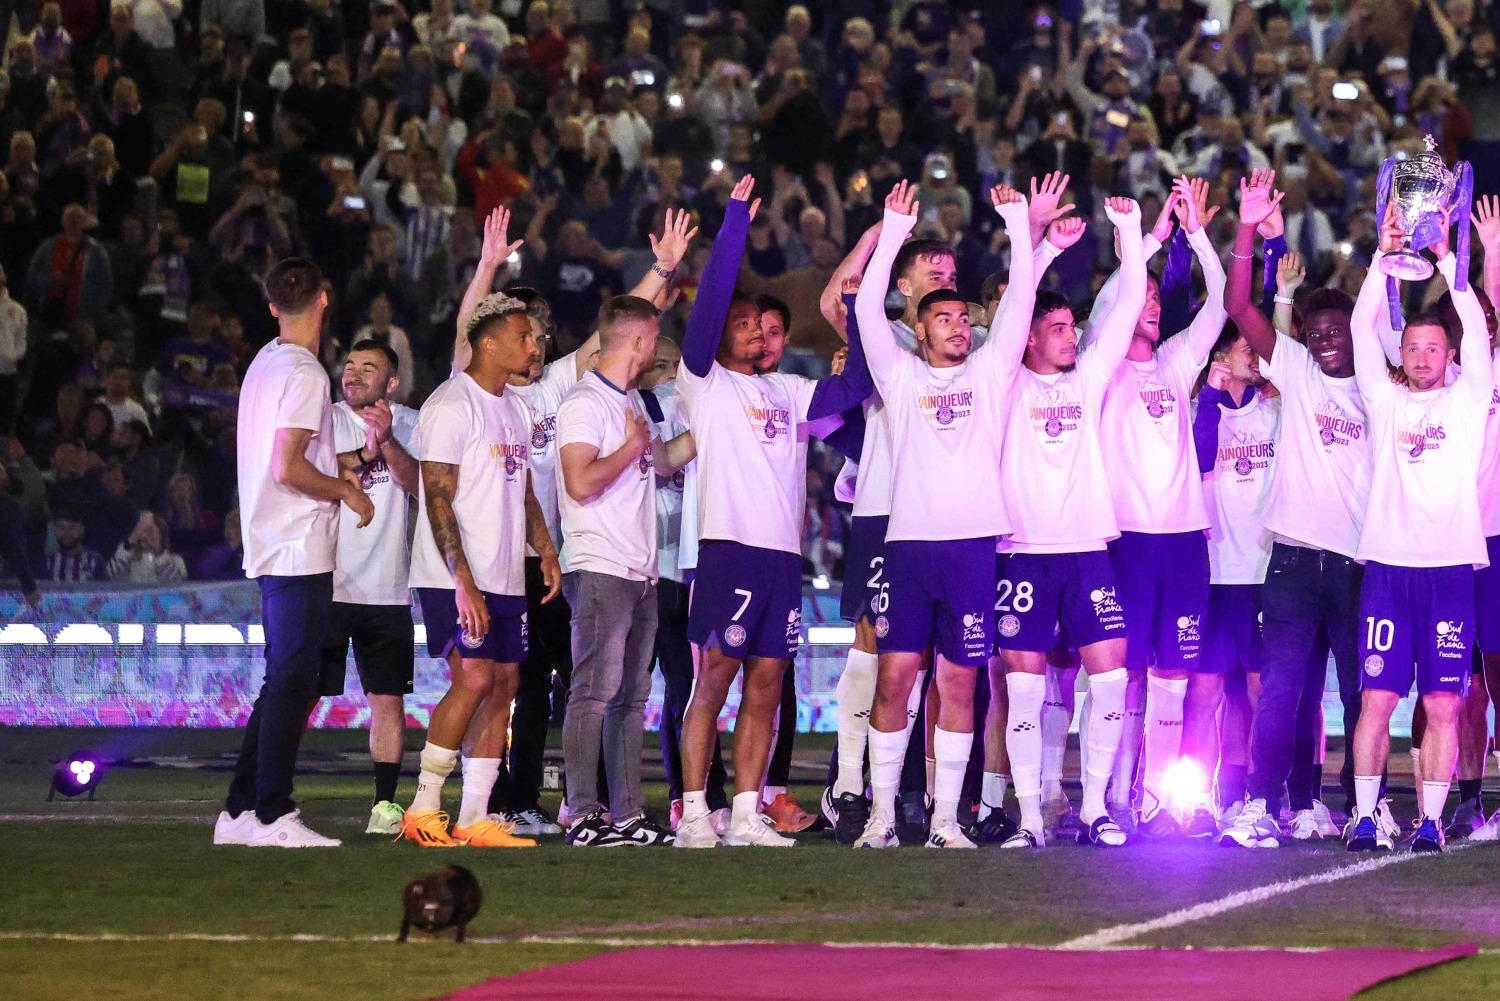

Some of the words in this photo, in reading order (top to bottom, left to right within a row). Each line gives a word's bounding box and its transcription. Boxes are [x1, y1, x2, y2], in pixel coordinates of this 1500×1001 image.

[954, 410, 971, 419] 2023
[1062, 423, 1078, 431] 2023
[1333, 436, 1350, 446] 2023
[1217, 442, 1275, 462] AINQUEURS
[1252, 461, 1268, 469] 2023
[994, 579, 1034, 613] 28
[1101, 586, 1116, 598] Sud
[731, 588, 752, 621] 7
[1104, 597, 1117, 605] de
[1448, 620, 1463, 634] Sud
[1366, 616, 1395, 651] 10
[1447, 633, 1460, 642] de
[1436, 634, 1466, 649] France
